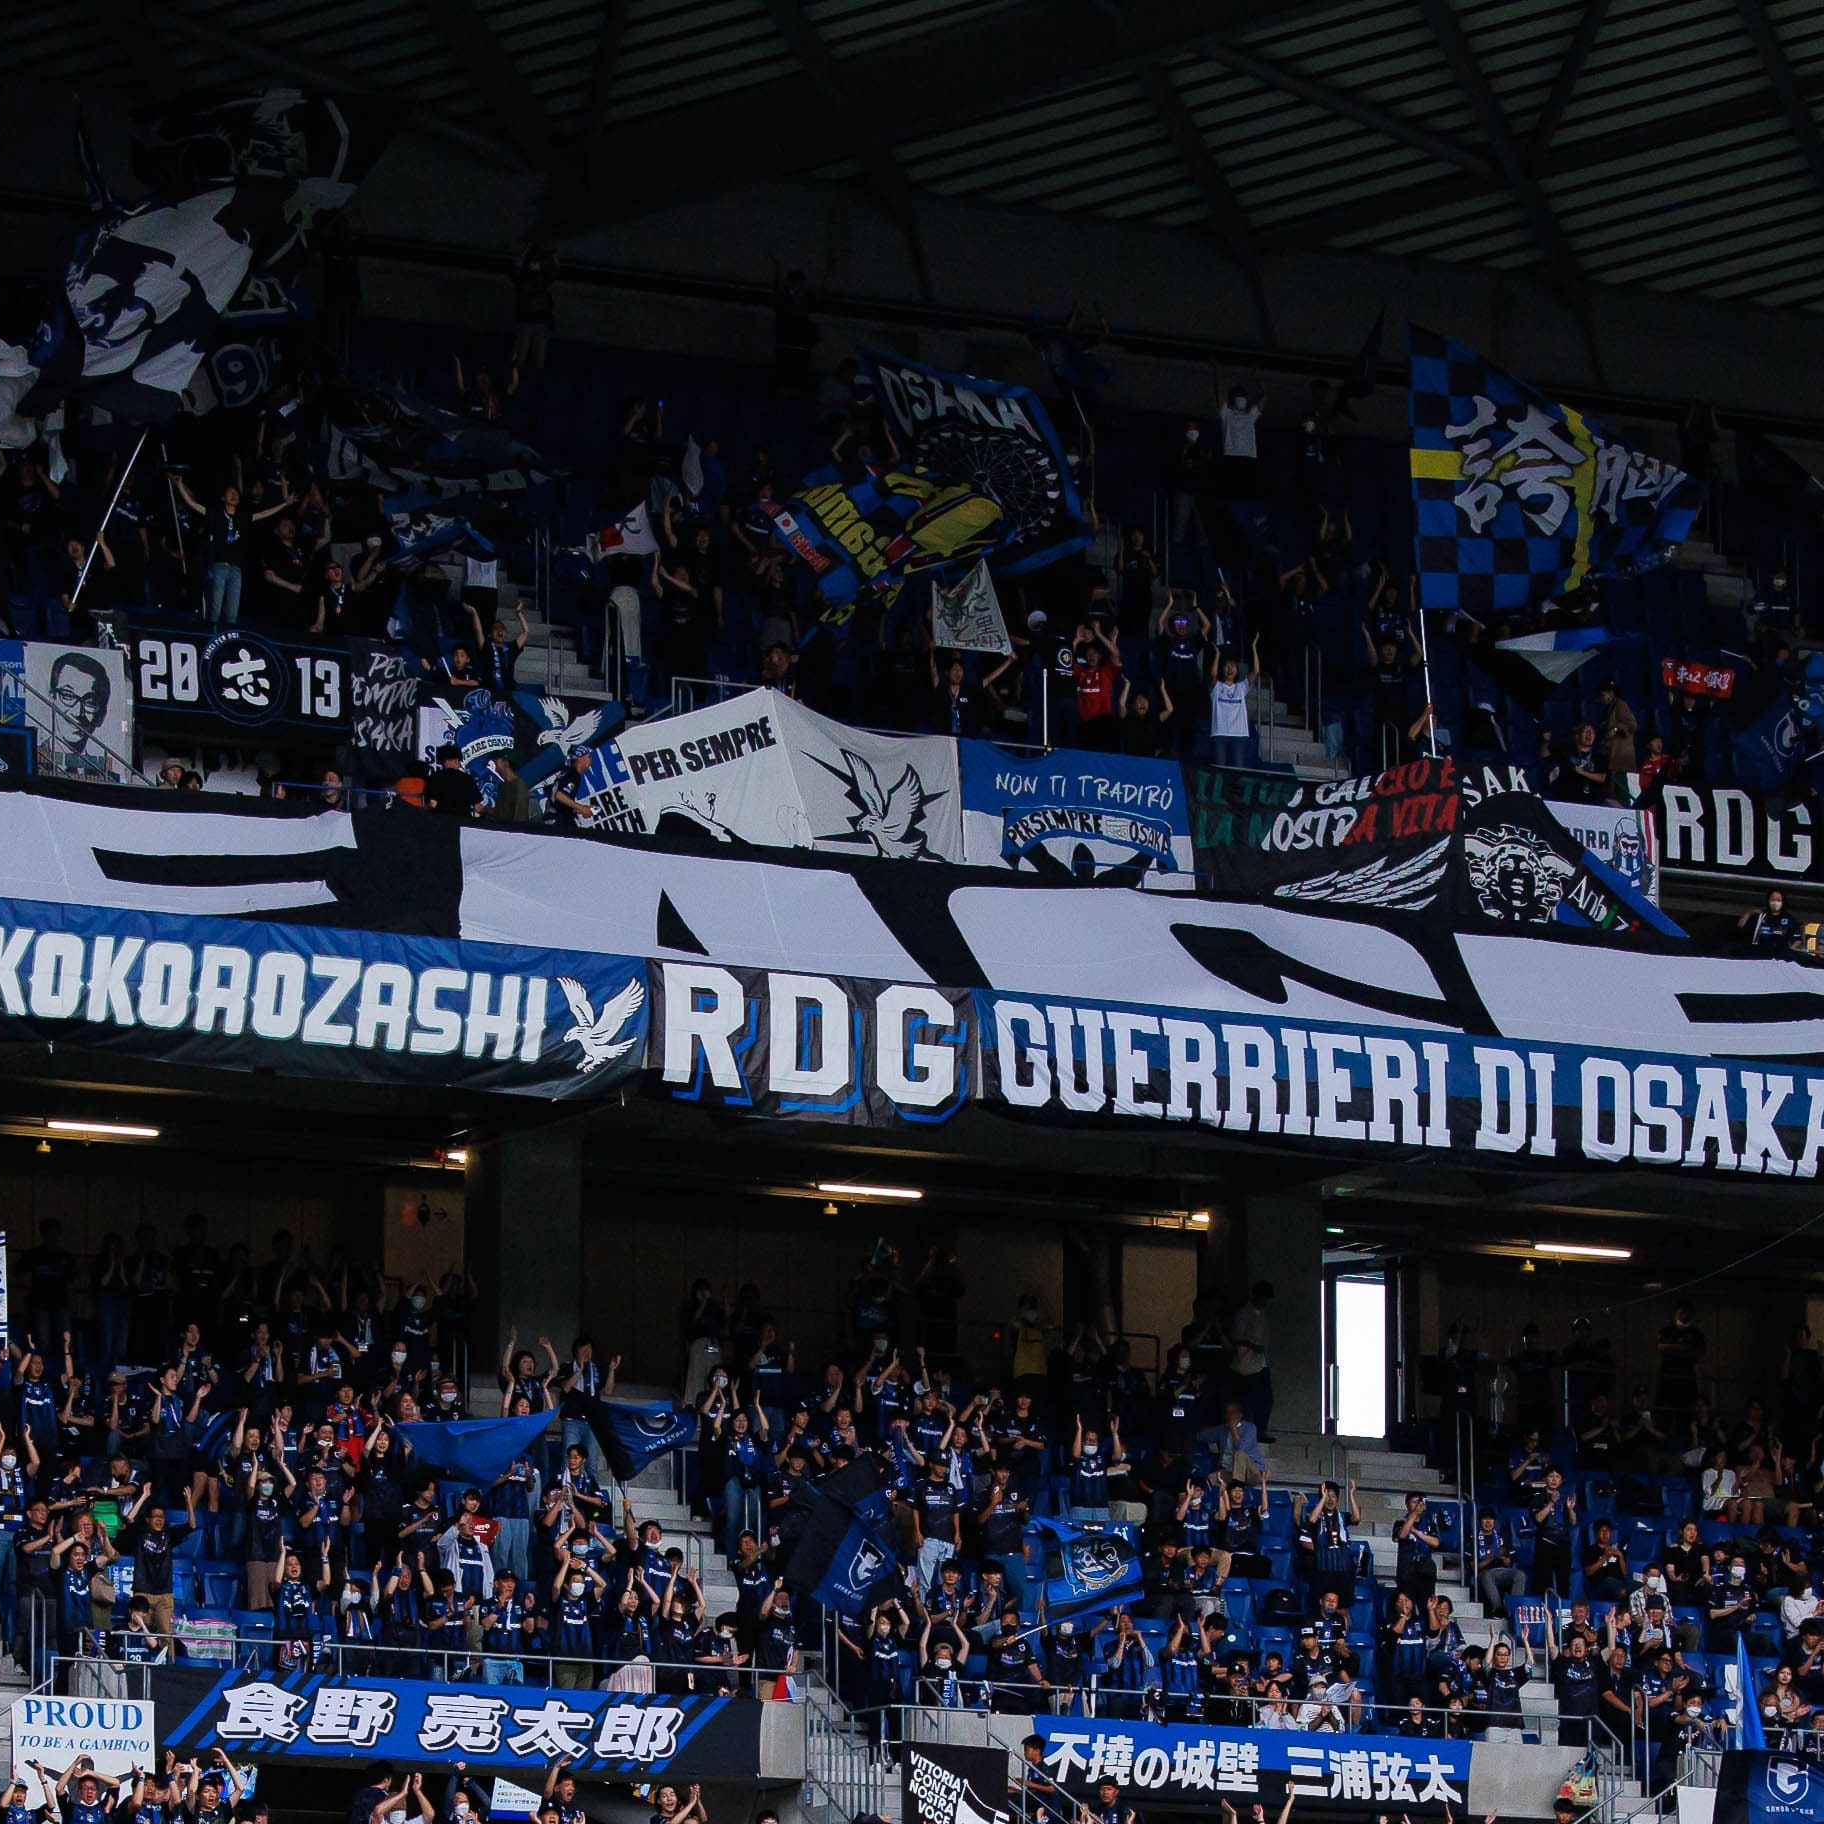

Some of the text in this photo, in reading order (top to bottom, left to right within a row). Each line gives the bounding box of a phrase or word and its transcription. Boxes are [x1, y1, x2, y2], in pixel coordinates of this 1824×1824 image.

[139, 639, 200, 703] 20
[222, 647, 272, 708] 志
[294, 655, 341, 720] 13
[368, 652, 409, 679] PER
[628, 716, 777, 786] PER SEMPRE
[995, 774, 1038, 797] NON
[1049, 775, 1068, 796] TI
[662, 961, 966, 1122] RDG
[994, 999, 1452, 1150] GUERRIERI
[1475, 1046, 1558, 1159] DI
[23, 1699, 143, 1731] PROUD
[217, 1682, 683, 1760] 食野 亮太郎
[19, 1735, 150, 1752] TO BE A GAMBINO
[909, 1751, 963, 1791] VITTORIA
[1044, 1731, 1464, 1805] 不撓の城壁 三浦弦太
[907, 1779, 957, 1813] NOSTRA
